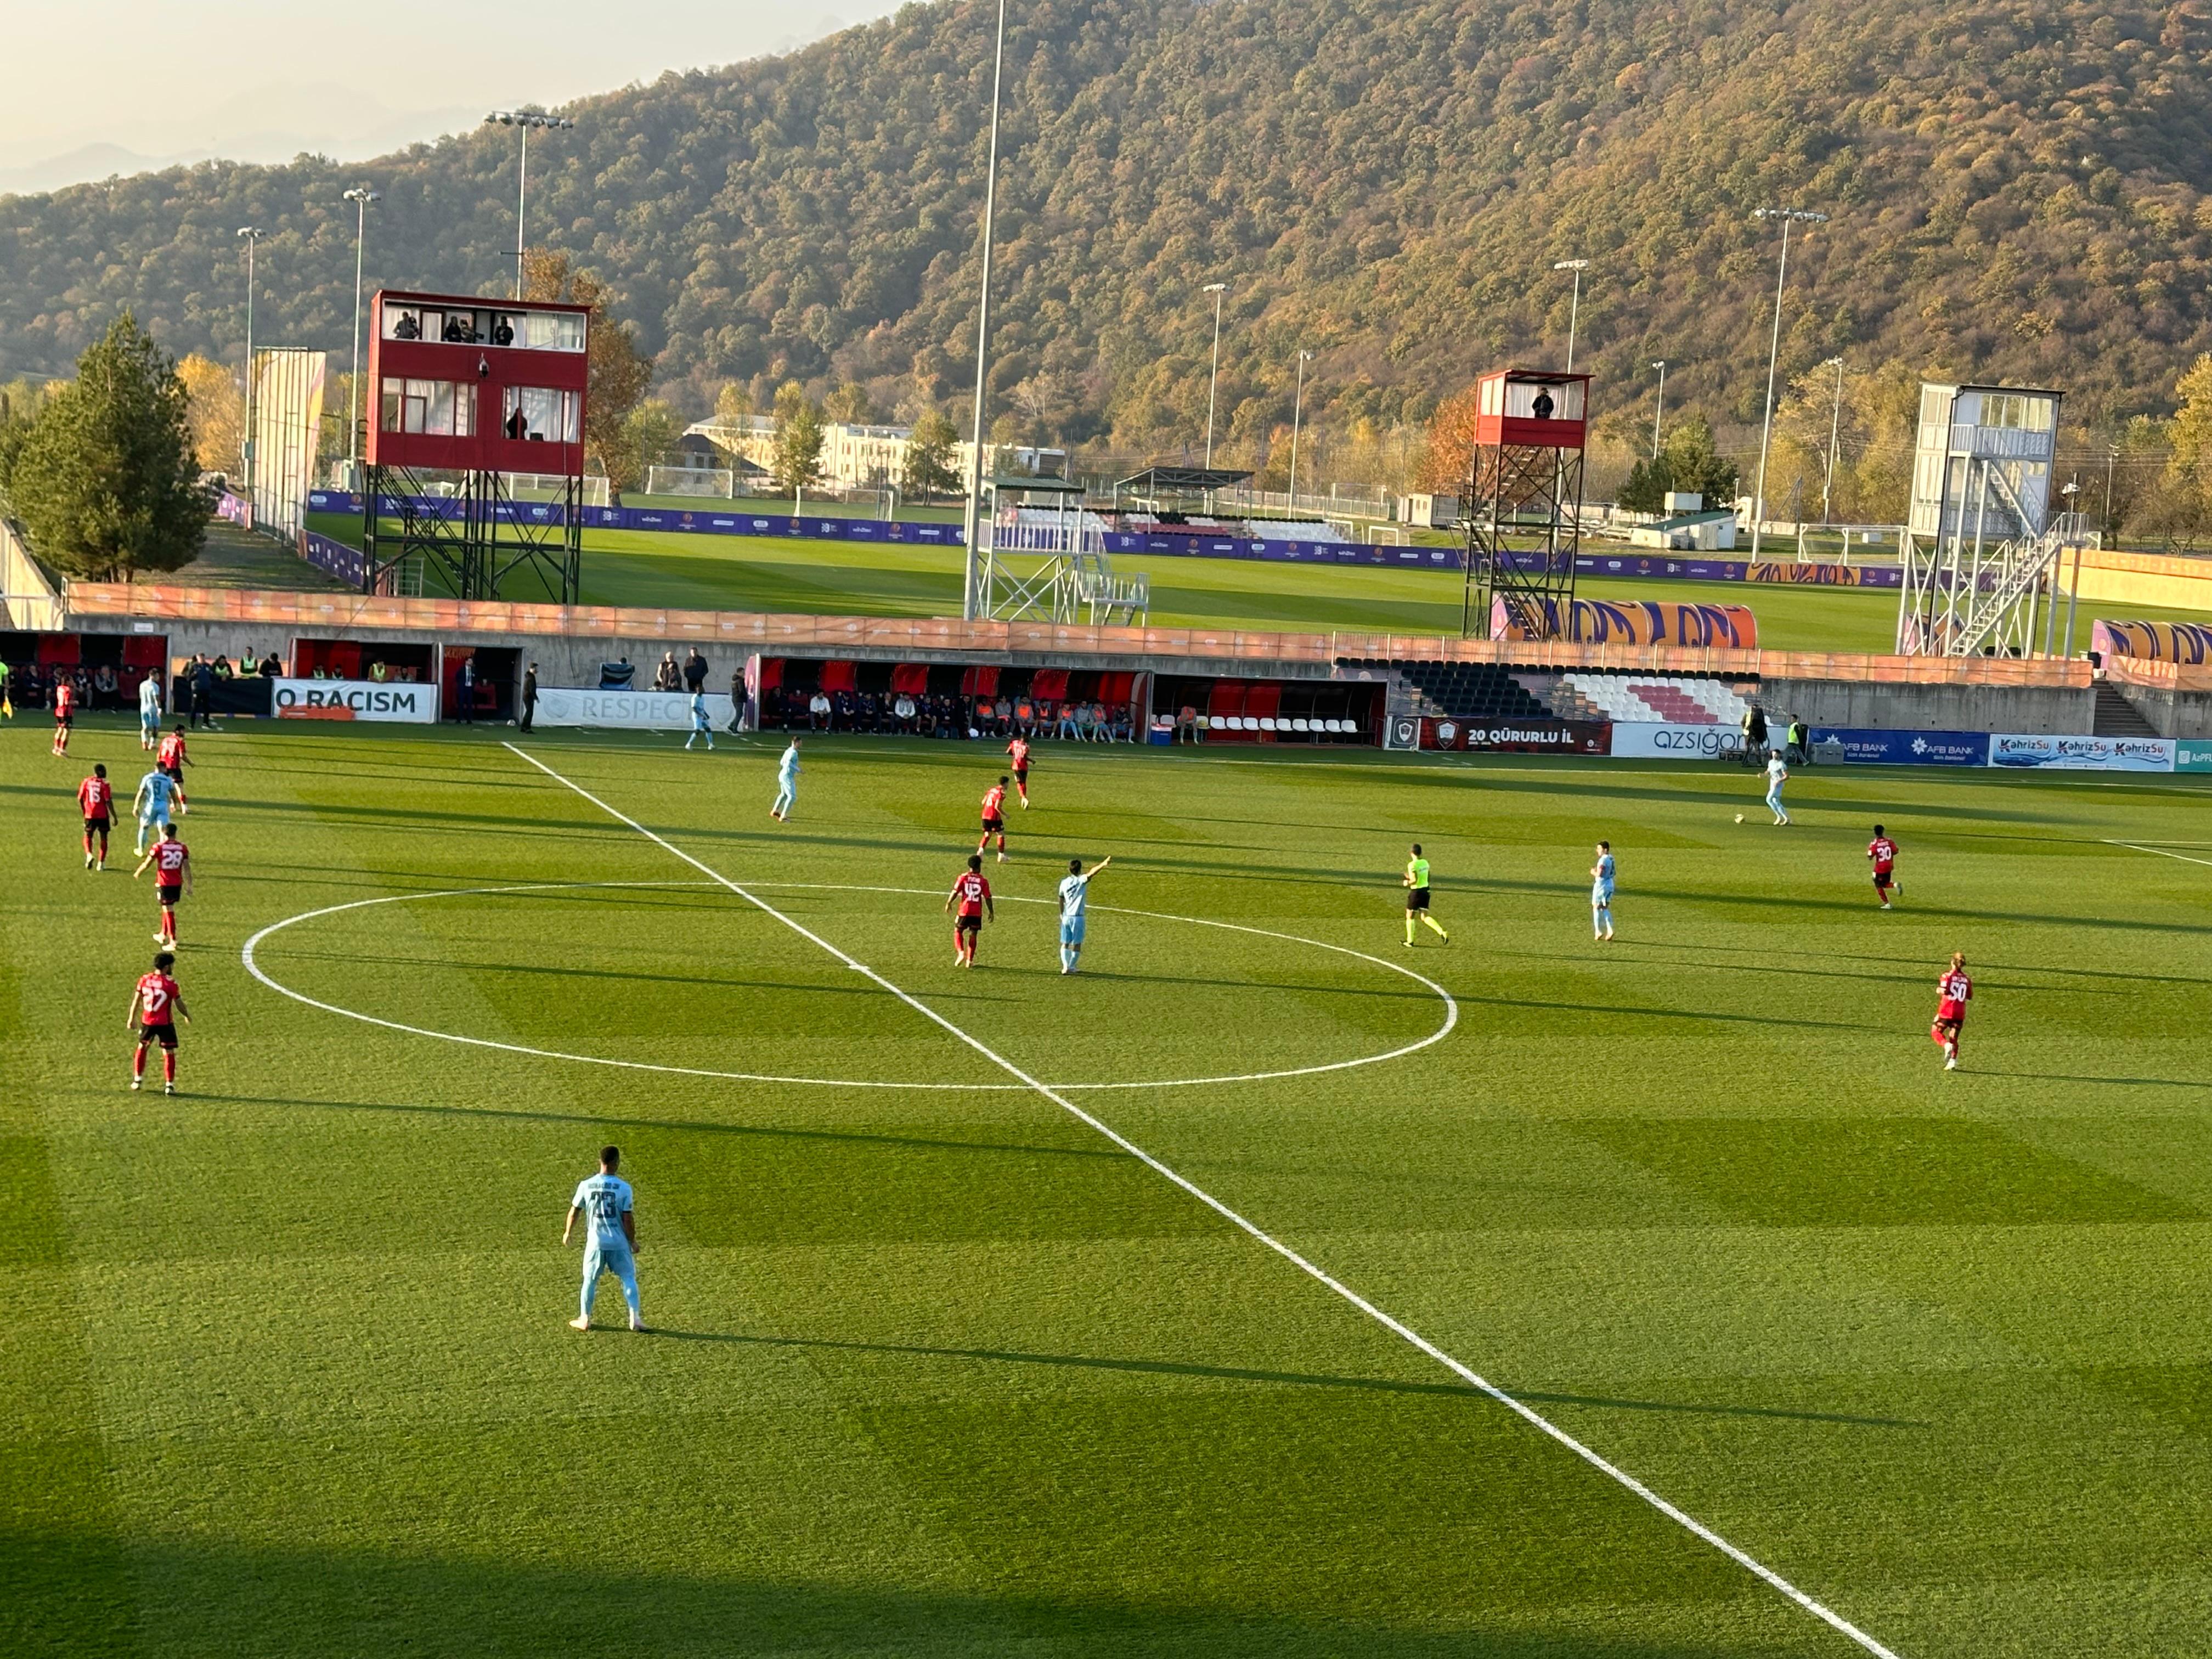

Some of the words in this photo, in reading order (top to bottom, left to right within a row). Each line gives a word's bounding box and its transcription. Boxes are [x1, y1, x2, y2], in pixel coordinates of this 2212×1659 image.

[276, 689, 296, 708] O
[307, 690, 415, 713] RACISM
[1468, 729, 1486, 741] 20
[1489, 727, 1558, 743] QÜRURLU
[1561, 729, 1575, 743] İL
[1862, 743, 1888, 752] BANK
[1926, 745, 1946, 753] AFB
[1948, 746, 1974, 754] BANK
[1877, 846, 1892, 862] 30
[1948, 982, 1967, 1002] 50
[591, 1192, 616, 1218] 23
